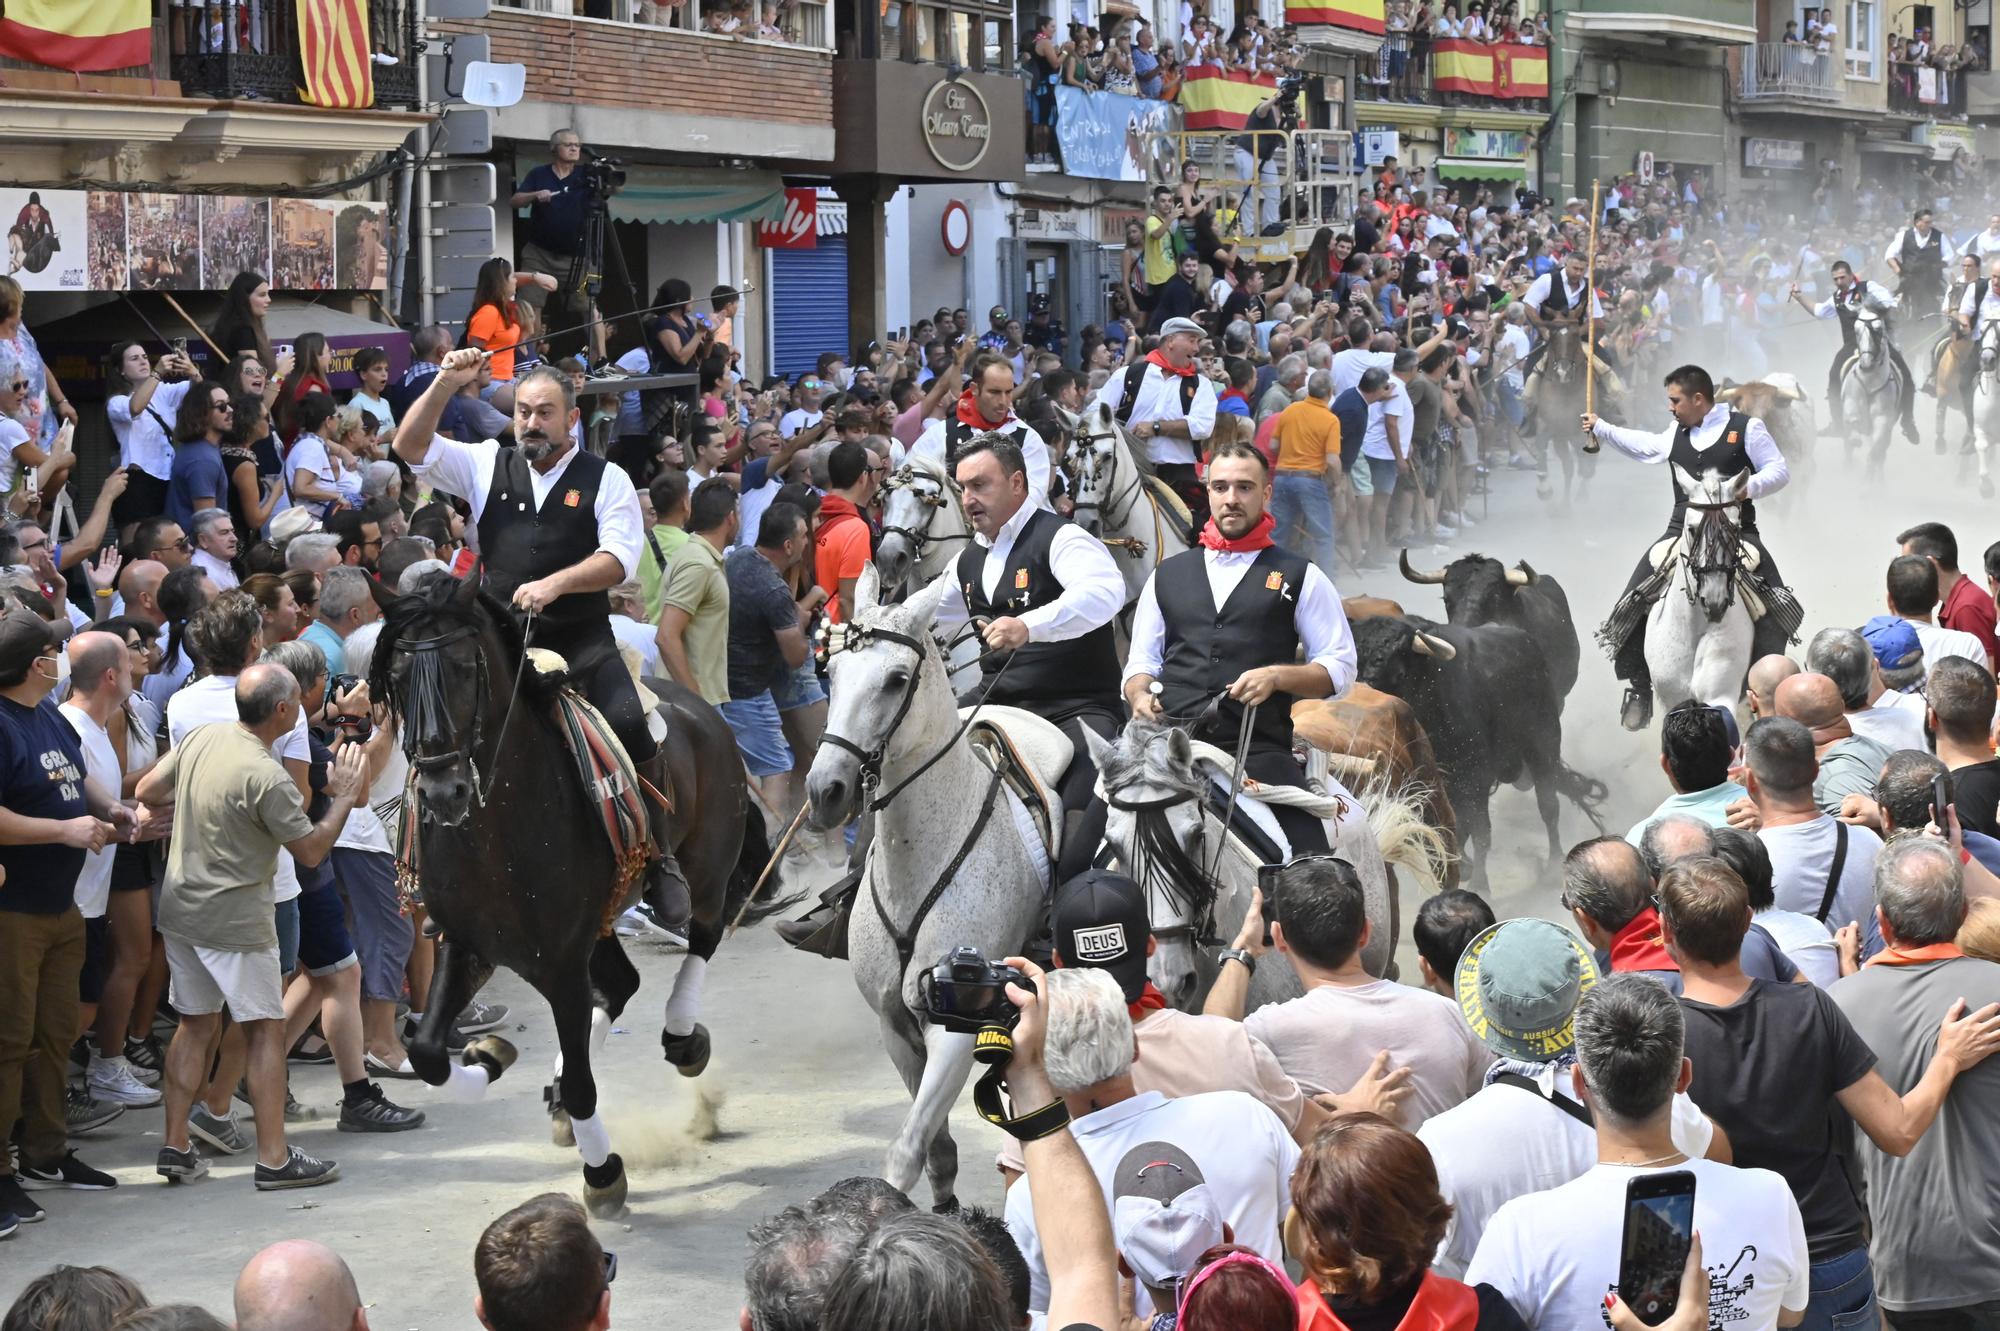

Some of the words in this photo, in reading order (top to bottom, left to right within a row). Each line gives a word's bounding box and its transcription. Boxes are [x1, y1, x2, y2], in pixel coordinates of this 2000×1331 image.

[40, 749, 69, 770] GRA
[64, 763, 81, 783] NA
[60, 783, 80, 801] DA
[1082, 932, 1118, 951] DEUS
[1523, 1027, 1557, 1040] AUSSIE
